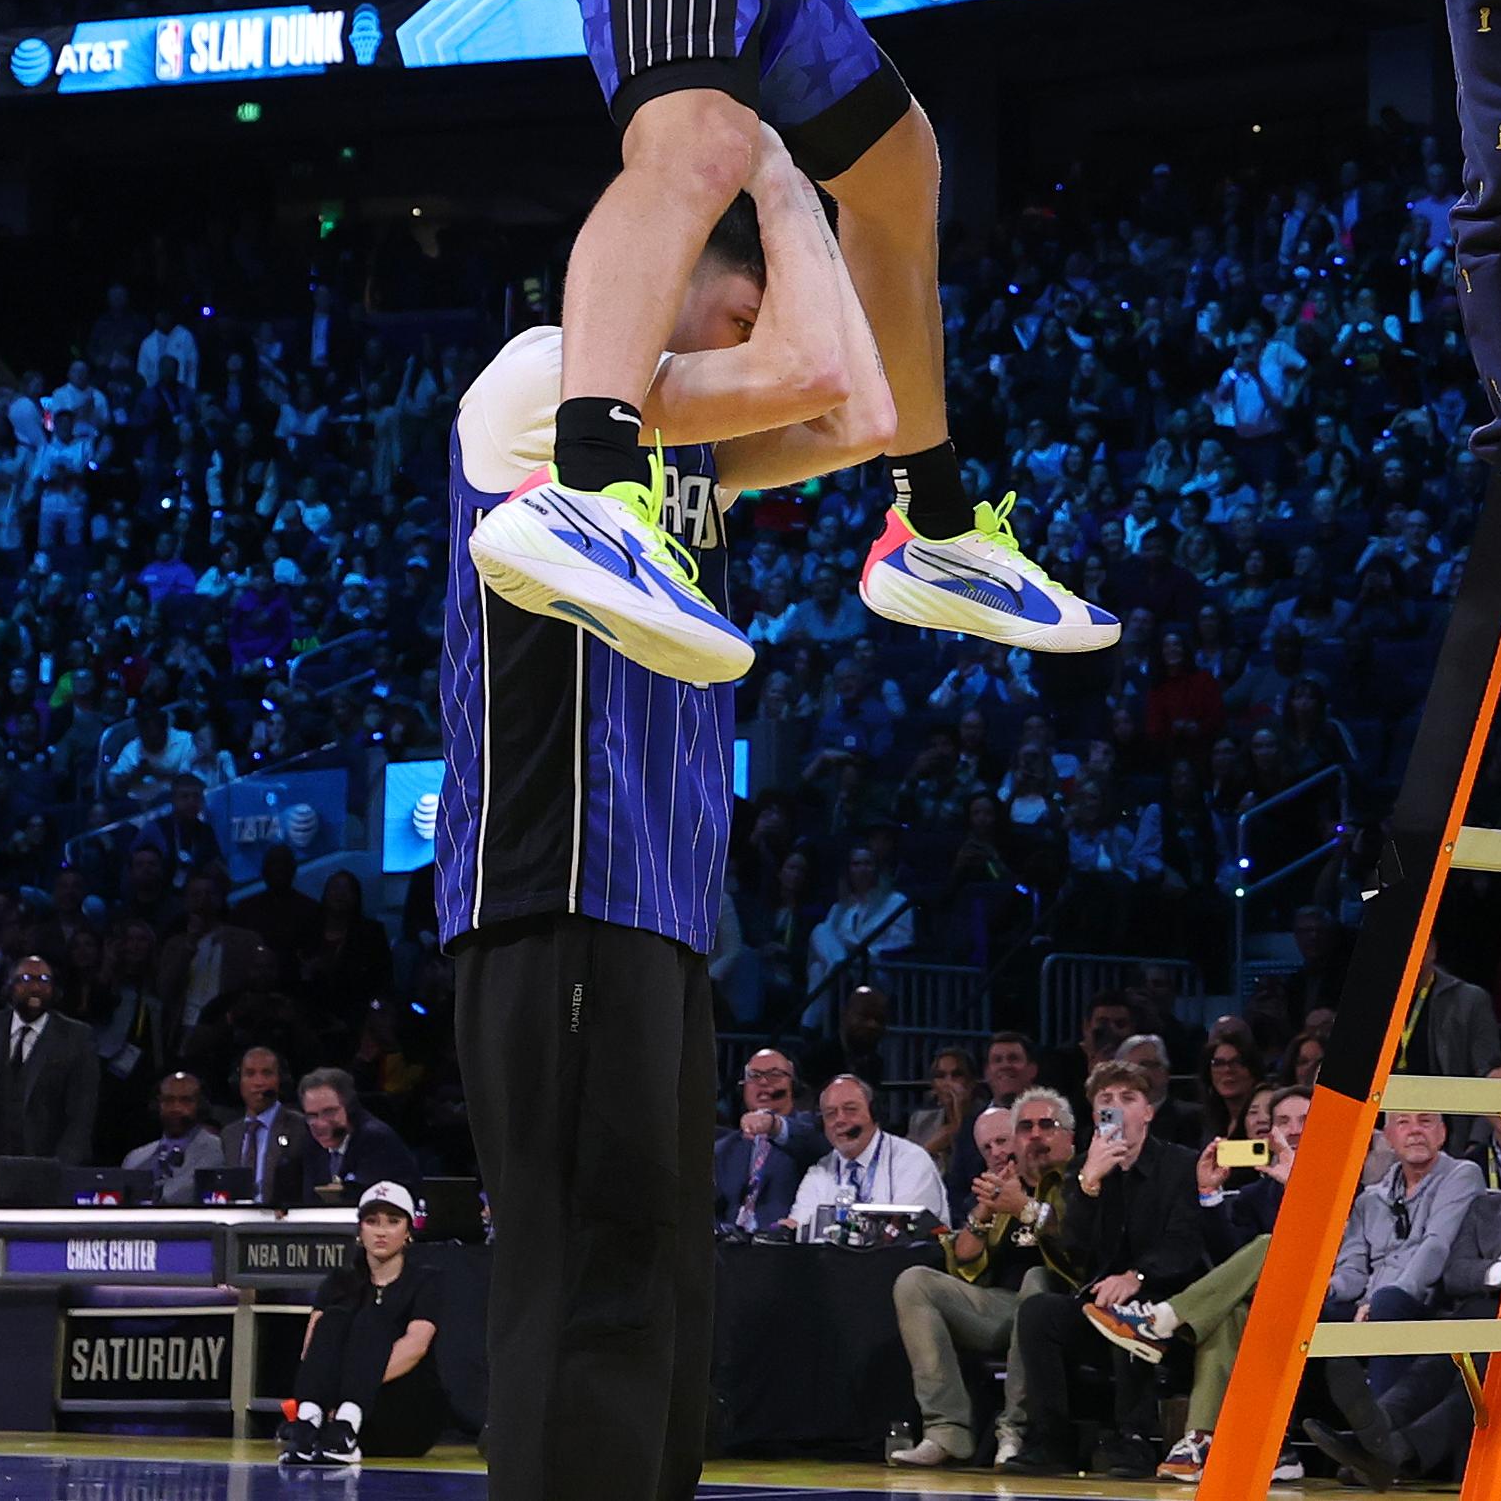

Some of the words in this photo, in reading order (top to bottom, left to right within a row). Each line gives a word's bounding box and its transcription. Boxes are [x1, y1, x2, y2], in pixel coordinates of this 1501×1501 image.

[55, 39, 129, 74] AT&T
[190, 19, 265, 73] SLAM
[270, 11, 344, 68] DUNK
[67, 1238, 108, 1271] CHASE
[109, 1238, 157, 1271] CENTER
[248, 1243, 279, 1267] NBA
[287, 1243, 308, 1267] ON
[316, 1243, 345, 1267] TNT
[71, 1336, 225, 1382] SATURDAY
